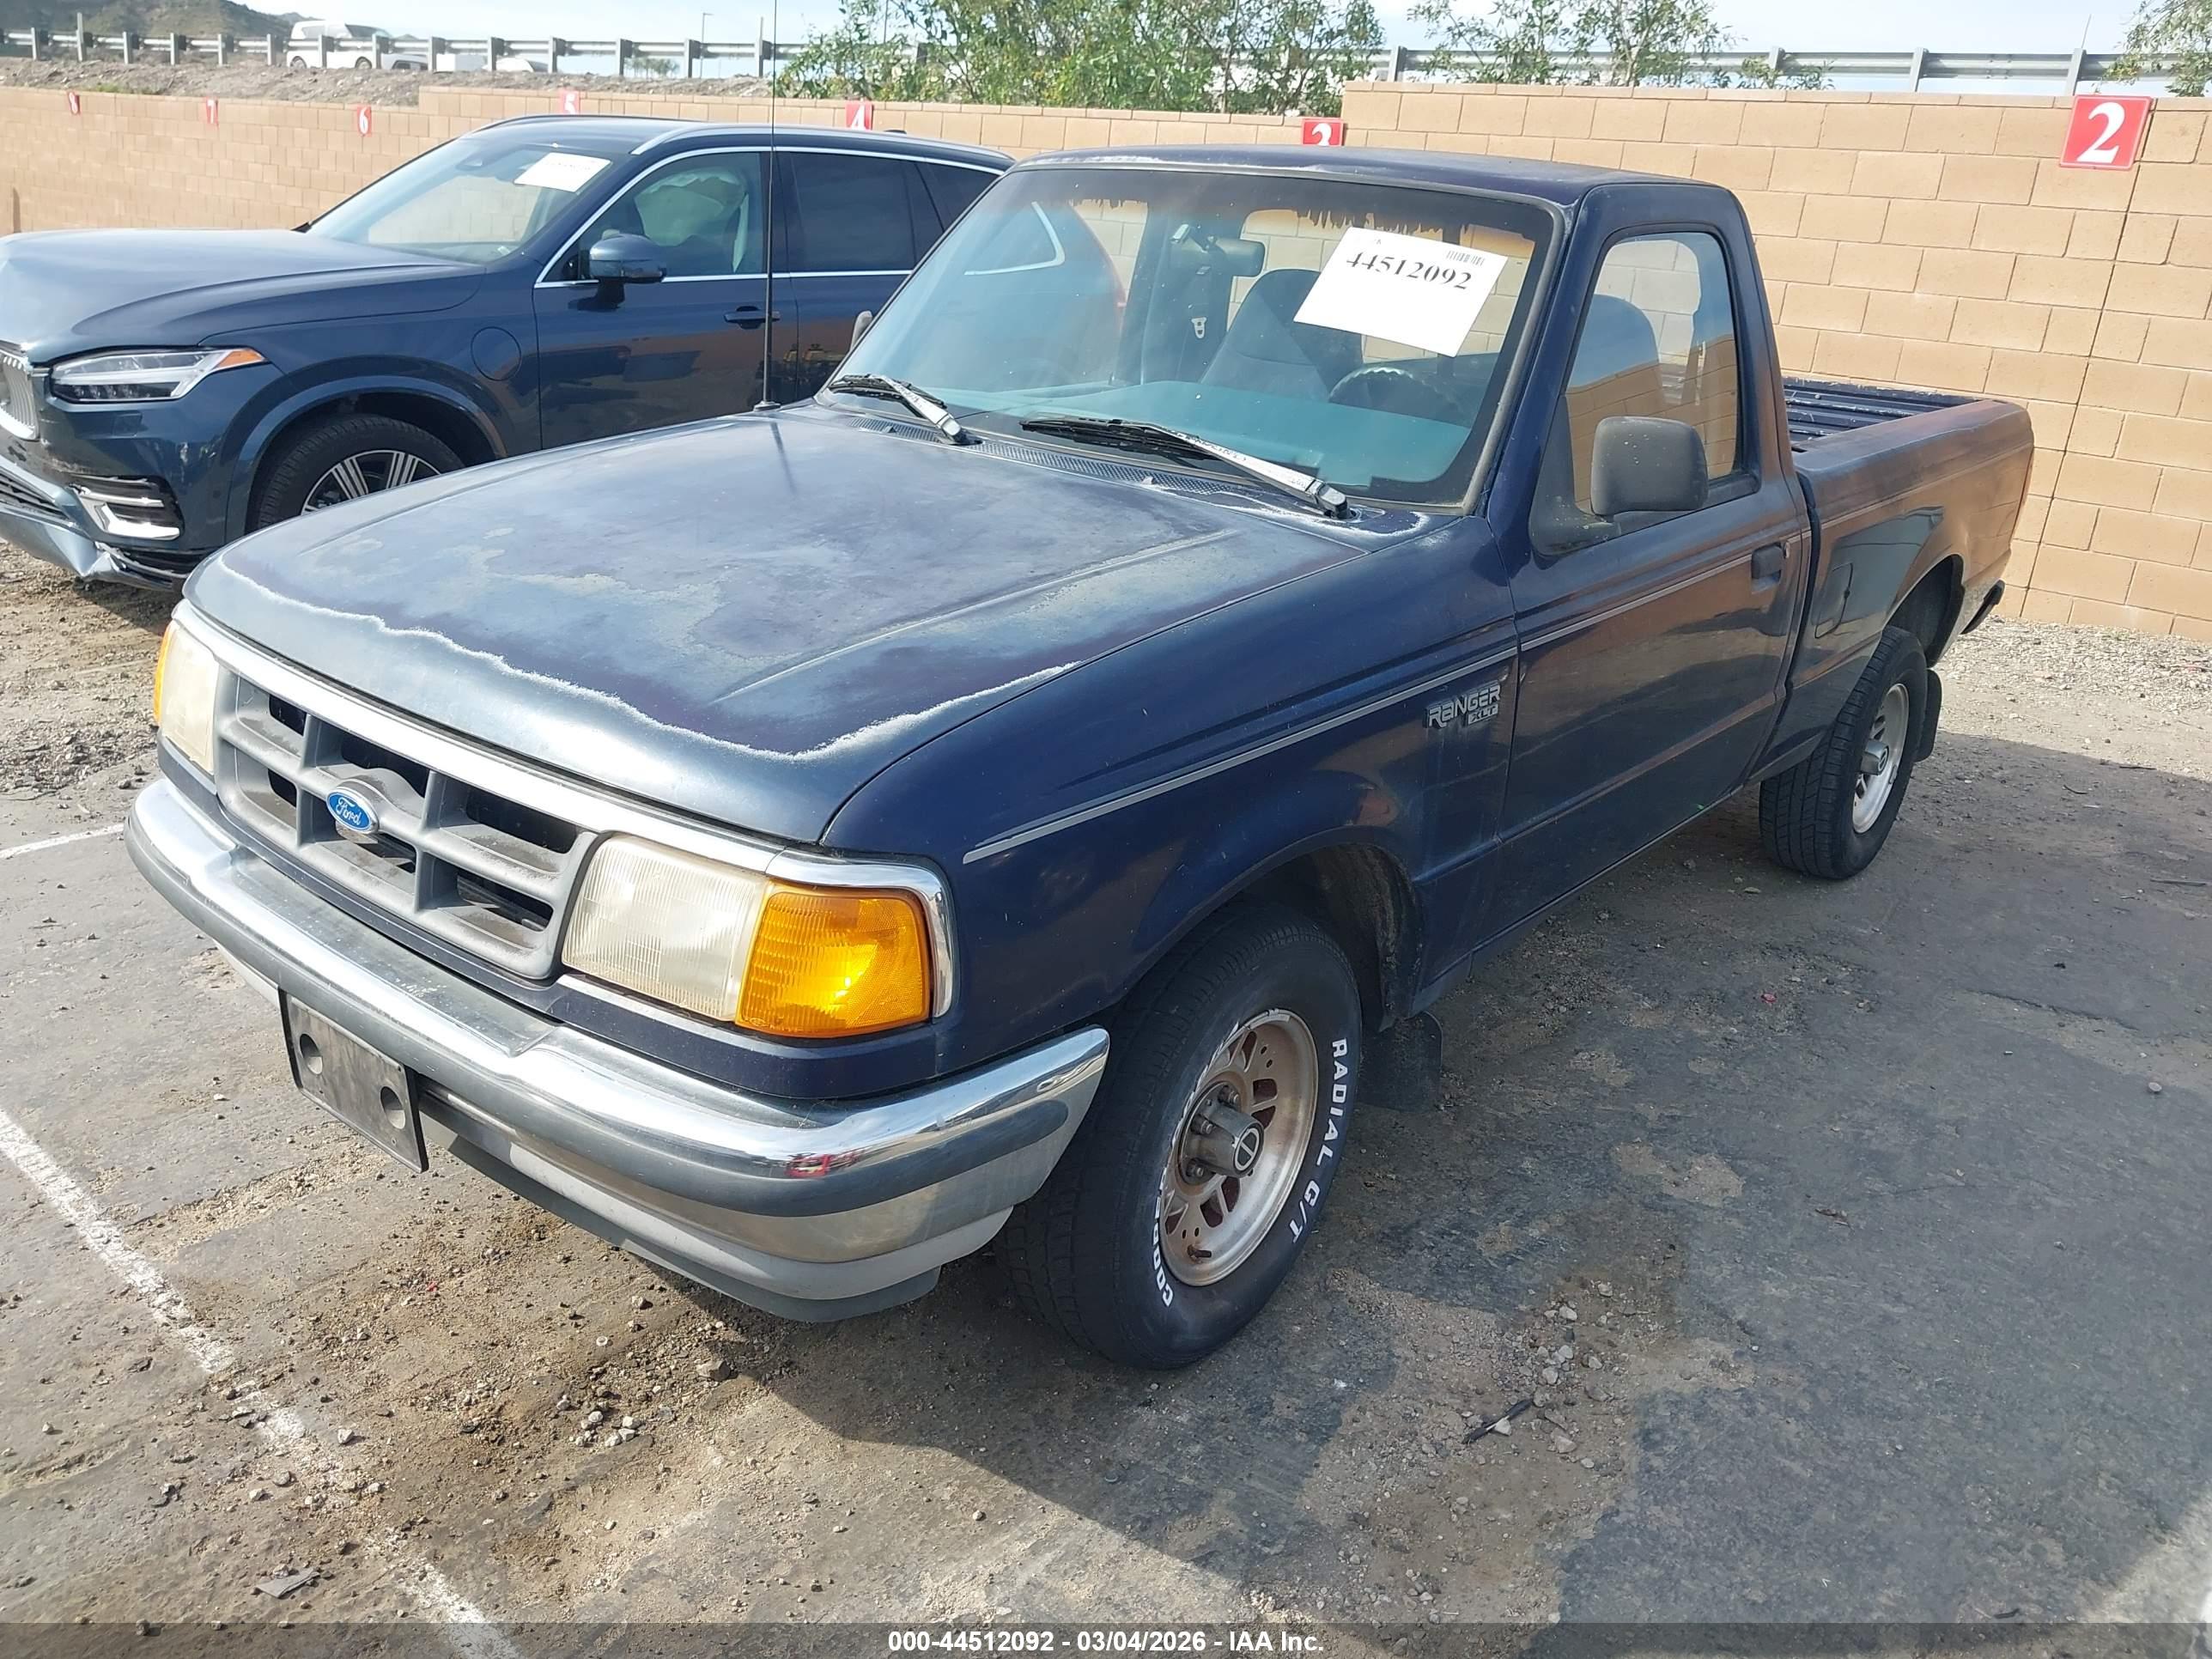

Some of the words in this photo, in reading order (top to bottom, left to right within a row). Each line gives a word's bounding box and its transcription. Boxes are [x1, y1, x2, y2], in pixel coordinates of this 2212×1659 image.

[69, 92, 79, 114] 8
[207, 99, 215, 124] 7
[851, 104, 868, 130] 4
[359, 107, 368, 134] 6
[2076, 102, 2125, 163] 2
[1346, 251, 1472, 289] 44512092
[1429, 684, 1501, 728] RANGER
[1471, 706, 1496, 723] XLT
[335, 797, 362, 826] Ford
[1316, 1038, 1349, 1166] RADIAL
[1289, 1180, 1321, 1244] G/T
